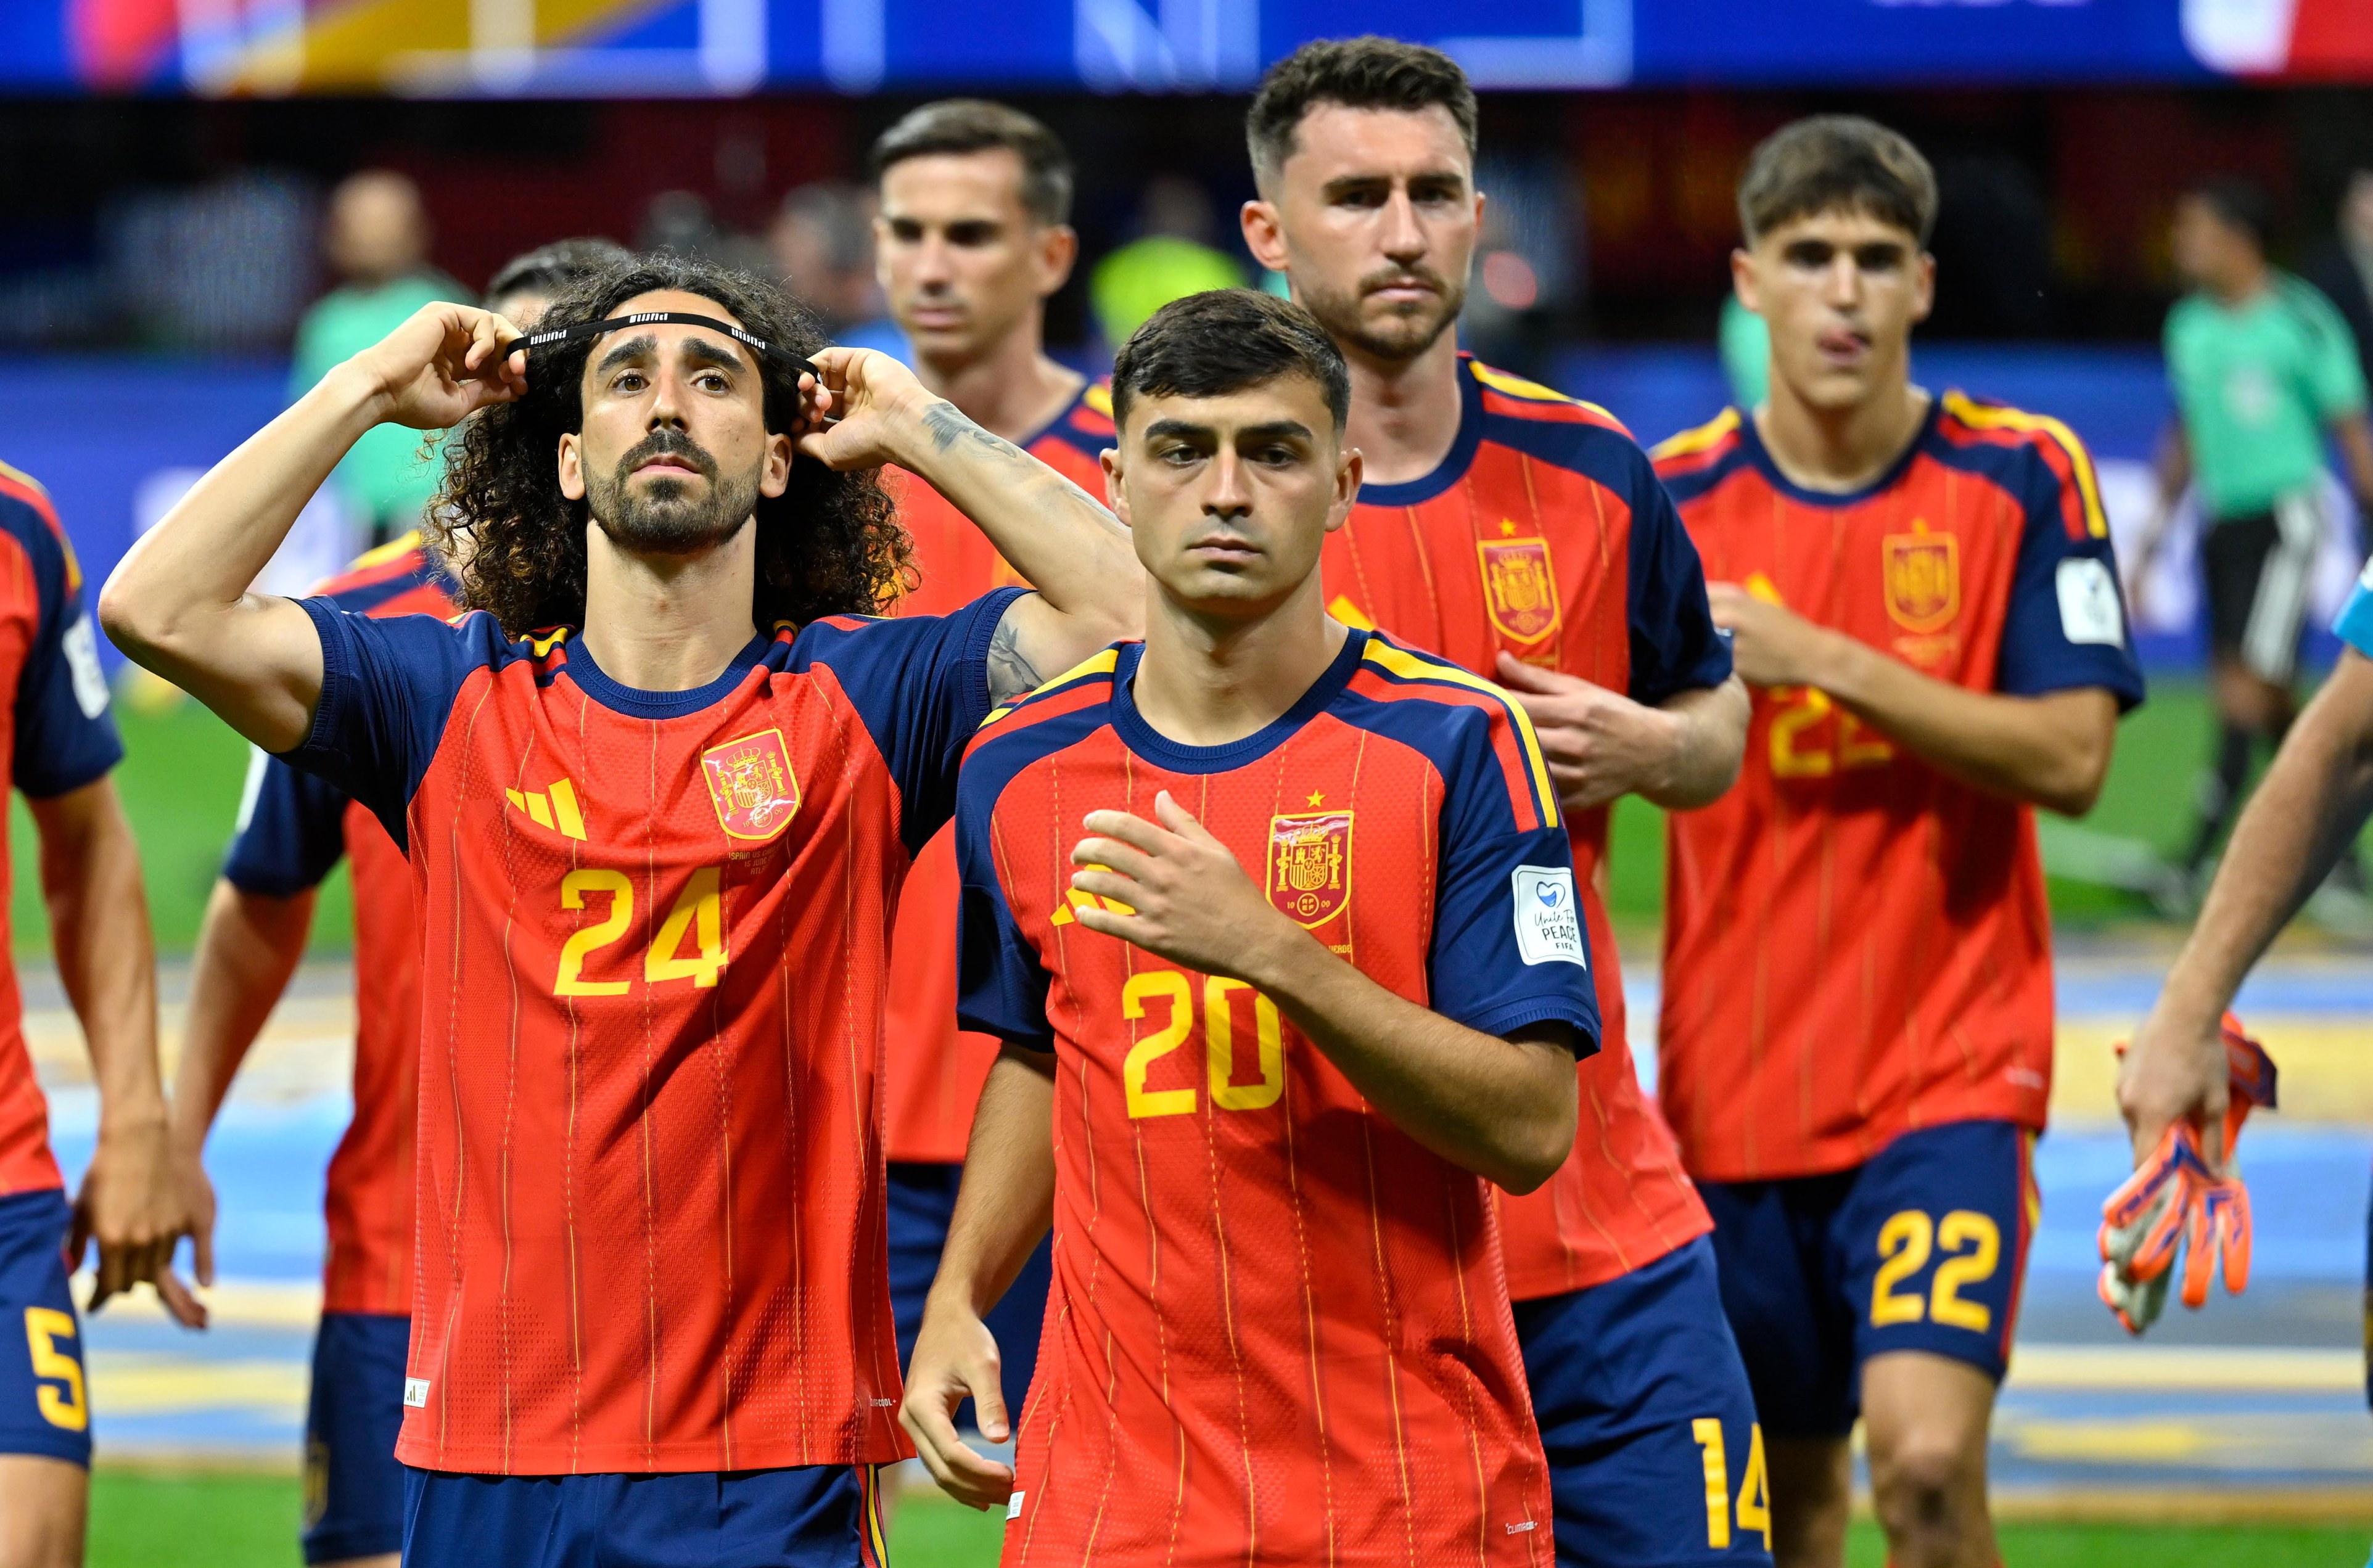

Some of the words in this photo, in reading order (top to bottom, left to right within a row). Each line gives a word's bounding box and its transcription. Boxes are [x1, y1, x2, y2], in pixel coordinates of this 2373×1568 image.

[731, 852, 750, 861] SPAIN
[553, 867, 729, 996] 24
[1542, 925, 1577, 943] PEACE
[1555, 942, 1574, 951] FIFA
[1122, 970, 1284, 1119] 20
[1870, 1209, 2001, 1334] 22
[25, 1307, 86, 1432] 5
[1692, 1418, 1771, 1551] 14
